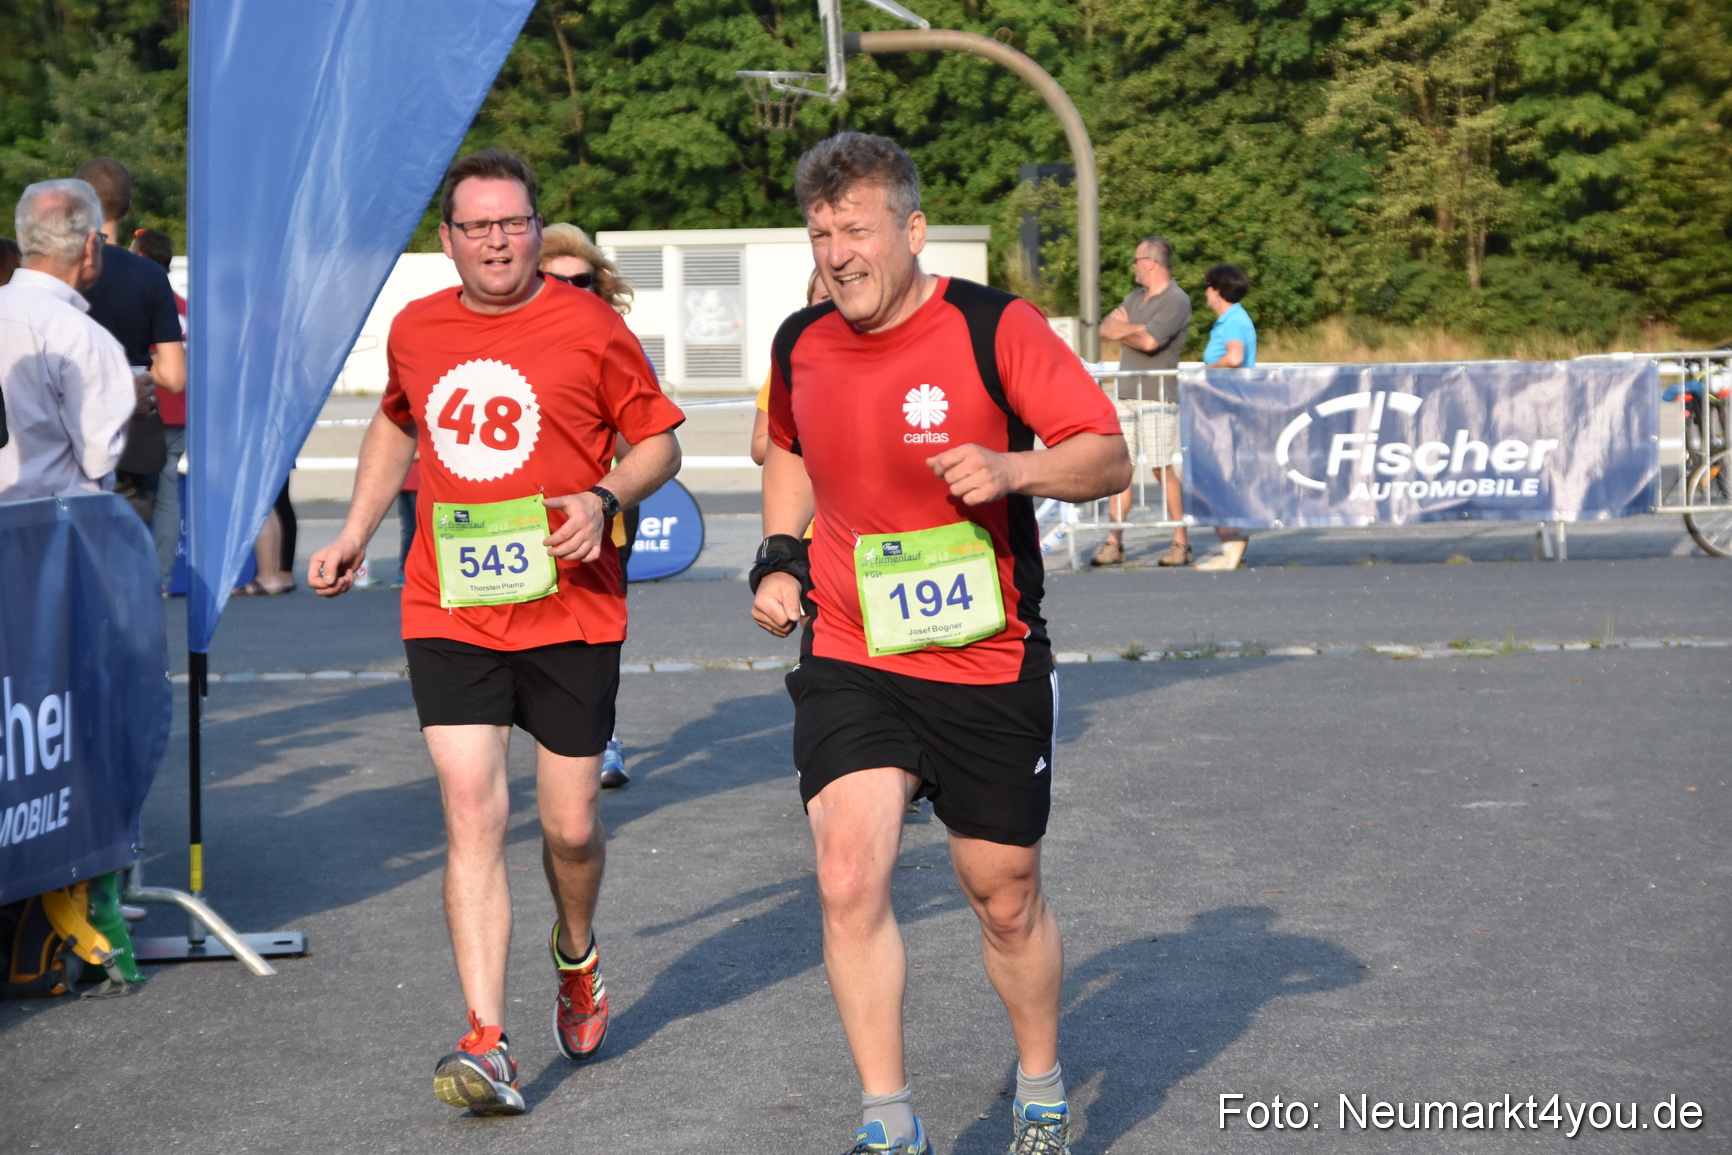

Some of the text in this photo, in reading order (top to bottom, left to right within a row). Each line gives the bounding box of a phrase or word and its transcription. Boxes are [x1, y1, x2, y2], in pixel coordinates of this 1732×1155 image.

[903, 430, 950, 443] caritas
[1327, 429, 1559, 476] Fischer
[1348, 478, 1540, 500] AUTOMOBILE
[636, 516, 679, 537] er
[632, 539, 670, 551] BILE
[459, 542, 529, 578] 543
[875, 550, 922, 565] firmenlauf
[470, 582, 525, 592] Thorsten Plamp
[889, 573, 974, 620] 194
[908, 622, 962, 636] Josef Bogner
